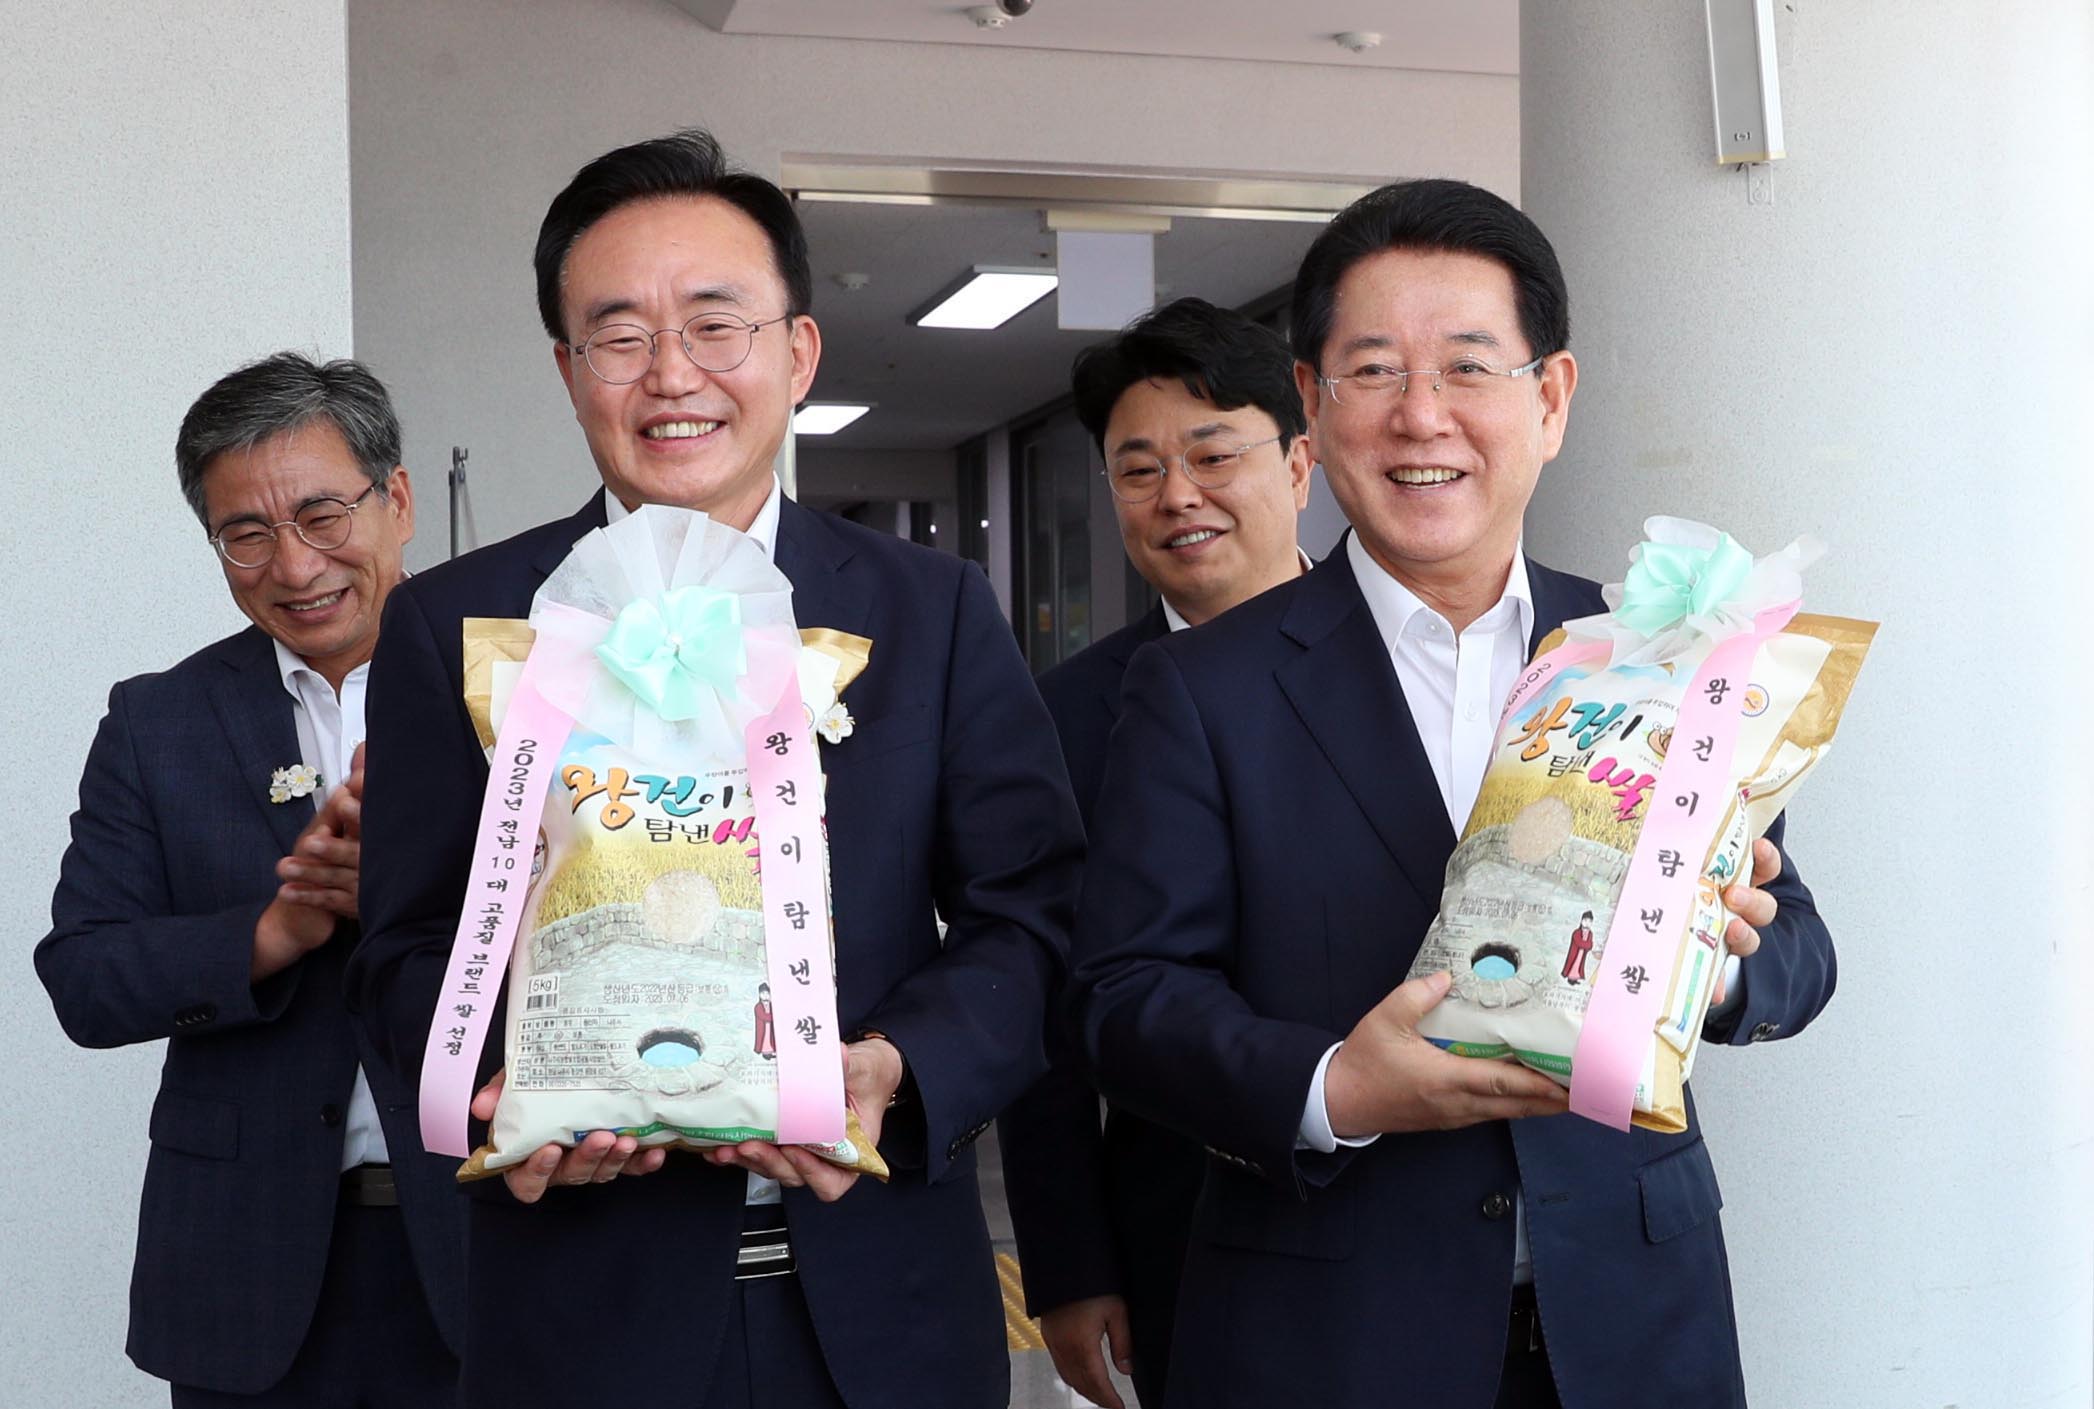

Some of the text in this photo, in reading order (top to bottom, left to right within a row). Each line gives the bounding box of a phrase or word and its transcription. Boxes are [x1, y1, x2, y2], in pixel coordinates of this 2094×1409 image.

[1507, 697, 1643, 761] 왕건이
[504, 739, 537, 811] 2023년
[561, 764, 734, 831] 왕건이
[497, 819, 520, 849] 전남
[644, 817, 710, 844] 탐낸
[473, 903, 504, 945] 고품질
[458, 953, 490, 995] 브랜드
[453, 1003, 477, 1019] 쌀
[442, 1026, 467, 1056] 선정
